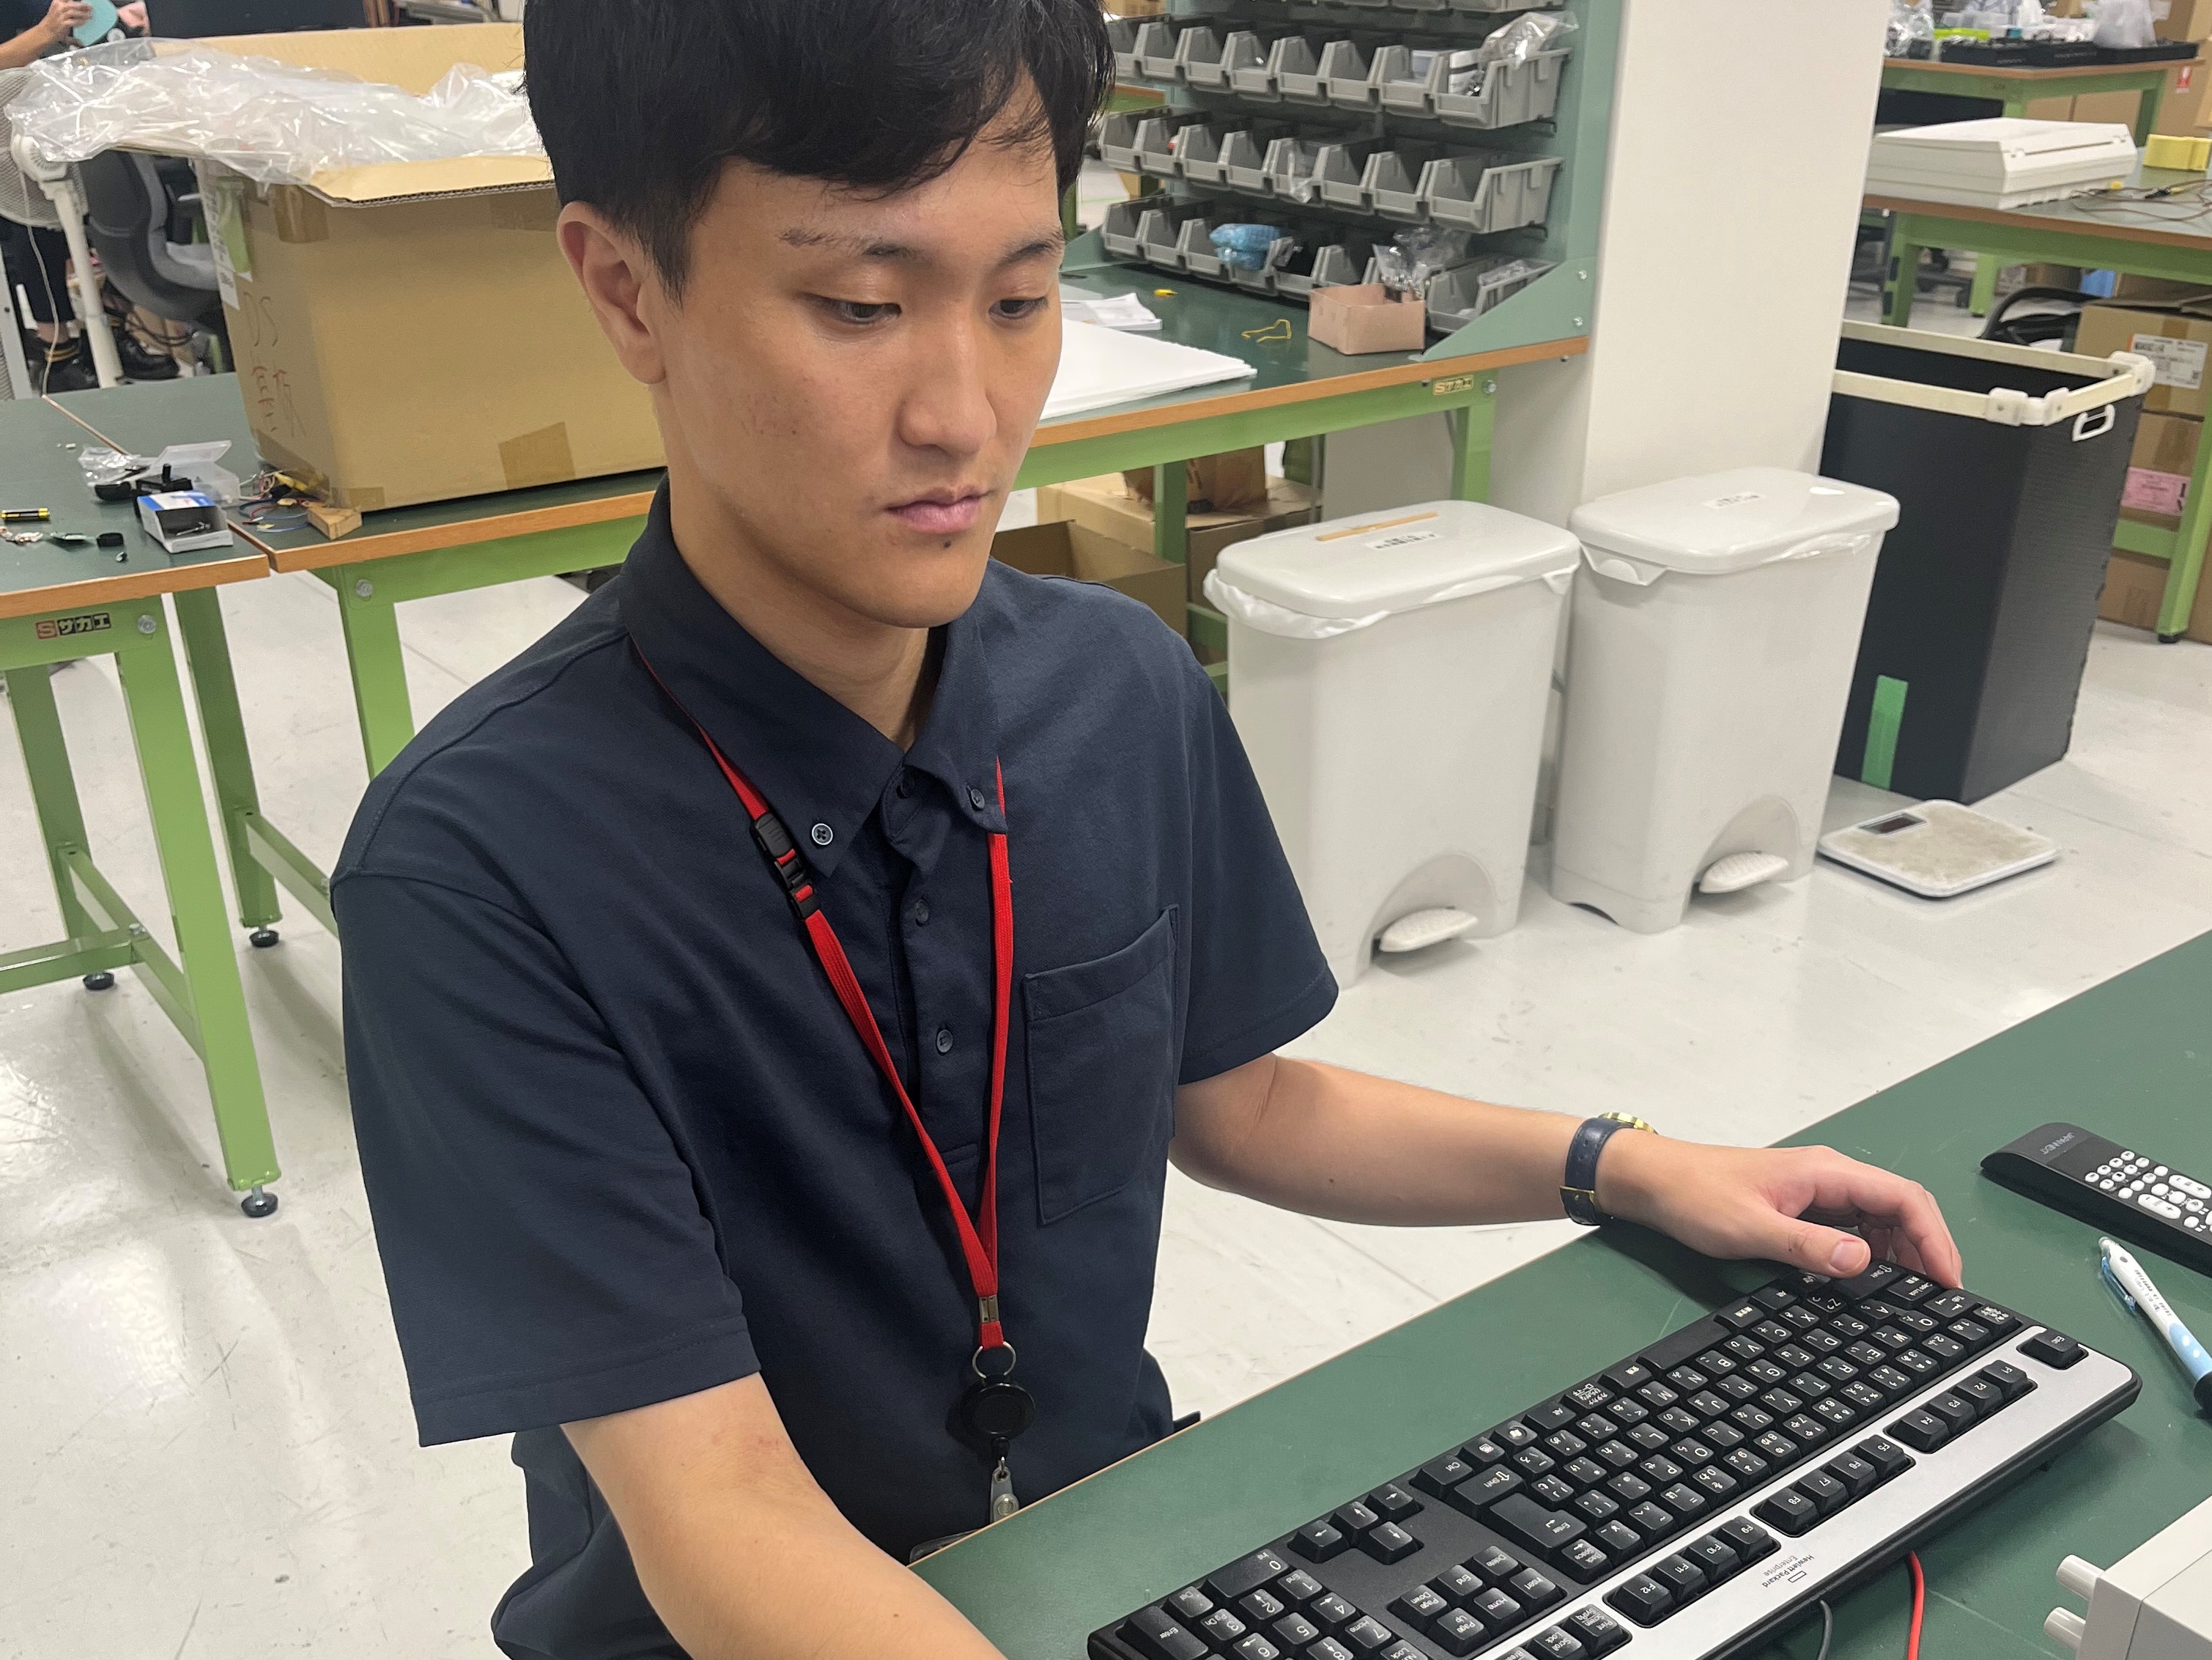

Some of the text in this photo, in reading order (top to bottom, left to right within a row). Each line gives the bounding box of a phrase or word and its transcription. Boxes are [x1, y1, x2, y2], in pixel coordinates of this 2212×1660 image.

[1827, 1298, 1841, 1307] Z
[1876, 1306, 1889, 1314] A
[1800, 1313, 1815, 1322] X
[1918, 1318, 1934, 1327] Q
[1851, 1322, 1864, 1330] S
[1774, 1329, 1789, 1337] C
[1893, 1333, 1908, 1343] W
[1824, 1337, 1838, 1346] D
[1747, 1344, 1760, 1353] V
[1866, 1349, 1882, 1358] E
[1799, 1352, 1810, 1361] F
[1717, 1358, 1732, 1368] B
[1766, 1368, 1780, 1376] G
[1838, 1364, 1854, 1373] R
[2001, 1366, 2013, 1374] F1
[1687, 1373, 1703, 1384] N
[1737, 1383, 1753, 1393] H
[1813, 1382, 1827, 1390] T
[1846, 1387, 1857, 1395] え
[1974, 1382, 1987, 1391] F2
[1588, 1392, 1608, 1405] カタカナ
[1657, 1390, 1673, 1401] M
[1764, 1393, 1776, 1401] ん
[1711, 1400, 1721, 1409] J
[1783, 1398, 1797, 1407] Y
[1947, 1399, 1961, 1408] F3
[1552, 1407, 1564, 1416] Alt
[1679, 1415, 1695, 1426] K
[1754, 1414, 1769, 1424] U
[1920, 1416, 1934, 1425] F4
[1549, 1436, 1561, 1445] め
[1877, 1442, 1890, 1452] F5
[1737, 1450, 1747, 1458] 9
[1445, 1461, 1460, 1472] Ctrl
[1667, 1464, 1678, 1475] P
[1848, 1460, 1862, 1469] F6
[1698, 1472, 1711, 1480] わ
[1706, 1468, 1717, 1476] 0
[1483, 1477, 1501, 1488] Shift
[1819, 1478, 1831, 1487] F7
[1665, 1491, 1678, 1499] ほ
[1788, 1496, 1801, 1505] F8
[1552, 1521, 1571, 1534] Enter
[1741, 1524, 1754, 1533] F9
[1574, 1546, 1598, 1560] Space
[1706, 1543, 1722, 1554] F10
[1257, 1552, 1270, 1560] Ins
[1486, 1553, 1507, 1567] Delete
[1585, 1552, 1602, 1563] Back
[1674, 1563, 1690, 1574] F11
[1763, 1555, 1798, 1576] Enterprise
[1761, 1554, 1815, 1588] Hewlett Packard
[1285, 1573, 1301, 1584] End
[1455, 1574, 1472, 1585] End
[1523, 1576, 1544, 1590] Insert
[1302, 1582, 1313, 1591] 1
[1640, 1582, 1657, 1594] F12
[1179, 1590, 1194, 1601] Del
[1410, 1591, 1432, 1604] Down
[1262, 1601, 1276, 1613] 2
[1419, 1597, 1439, 1609] Page
[1487, 1596, 1508, 1610] Home
[1334, 1604, 1344, 1615] 4
[1204, 1617, 1218, 1626] Dn
[1455, 1615, 1468, 1623] Up
[1584, 1613, 1608, 1626] Screen
[1226, 1620, 1240, 1631] 3
[1349, 1617, 1370, 1633] Home
[1457, 1620, 1476, 1633] Page
[1596, 1618, 1614, 1631] Print
[1159, 1626, 1179, 1639] Enter
[1296, 1625, 1310, 1637] 5
[1372, 1628, 1385, 1639] 7
[1545, 1631, 1566, 1644] Lock
[1551, 1636, 1572, 1651] Scroll
[1257, 1647, 1270, 1658] 6
[1333, 1651, 1345, 1660] 8
[1390, 1647, 1410, 1659] Lock
